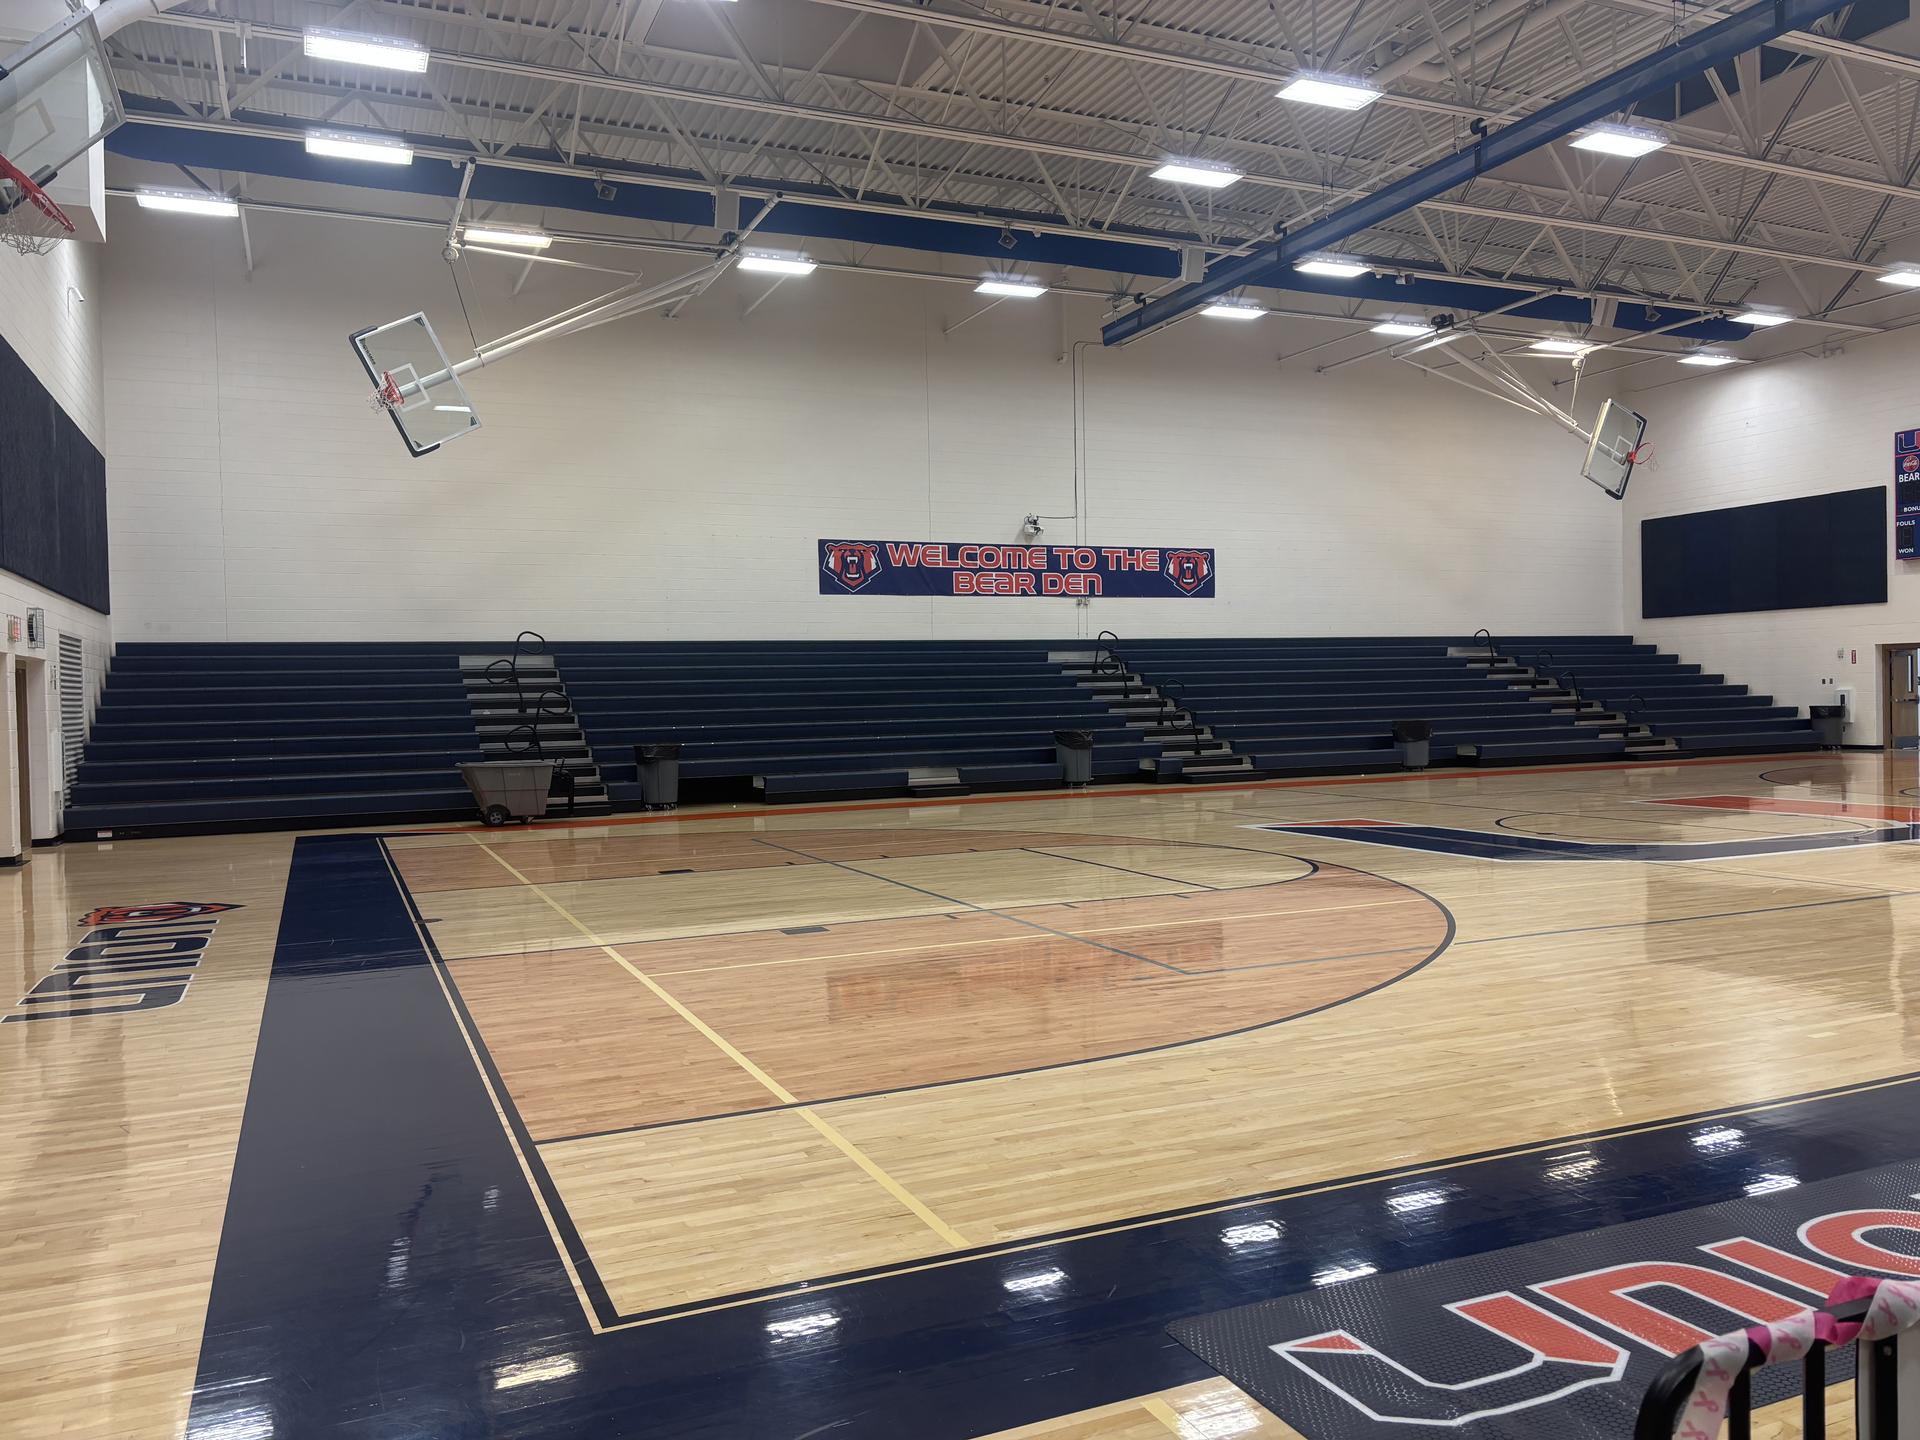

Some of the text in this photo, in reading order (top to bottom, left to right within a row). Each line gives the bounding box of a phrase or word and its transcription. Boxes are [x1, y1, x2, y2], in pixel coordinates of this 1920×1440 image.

[886, 543, 1160, 571] WELCOME TO THE
[952, 571, 1103, 595] BEAR DEN
[1268, 1191, 1920, 1427] UNIO
